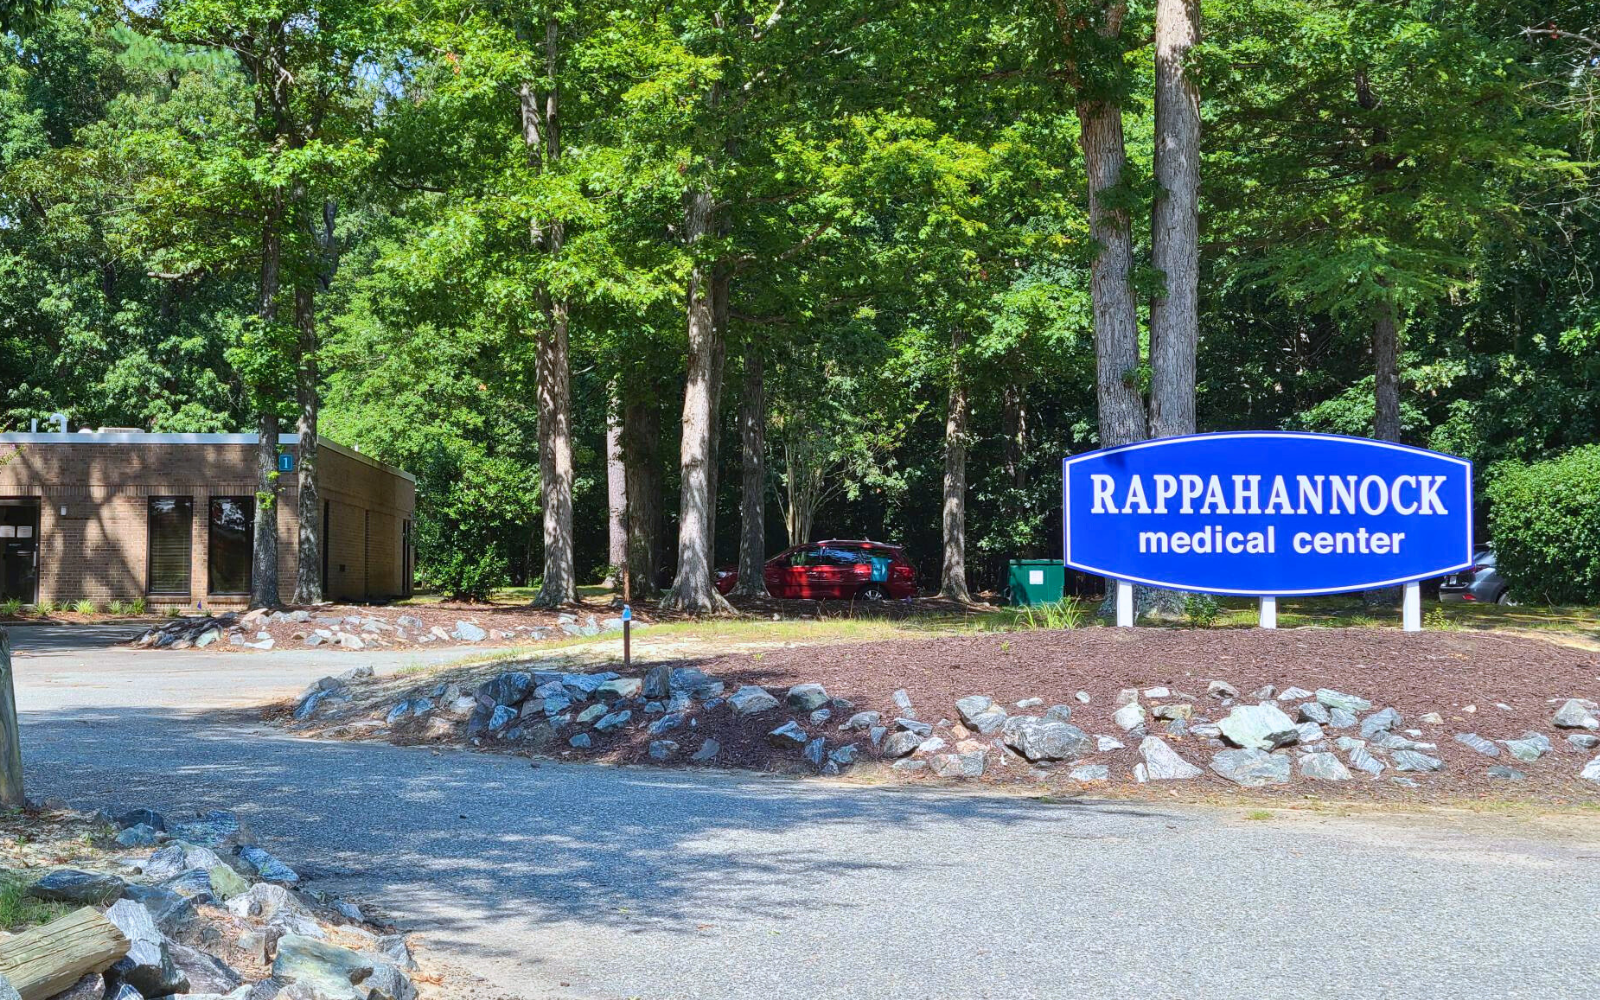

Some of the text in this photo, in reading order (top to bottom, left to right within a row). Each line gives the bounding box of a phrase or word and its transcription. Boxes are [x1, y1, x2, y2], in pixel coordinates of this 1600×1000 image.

[283, 457, 289, 469] 1
[1090, 474, 1449, 515] RAPPAHANNOCK
[1138, 525, 1406, 555] medical center
